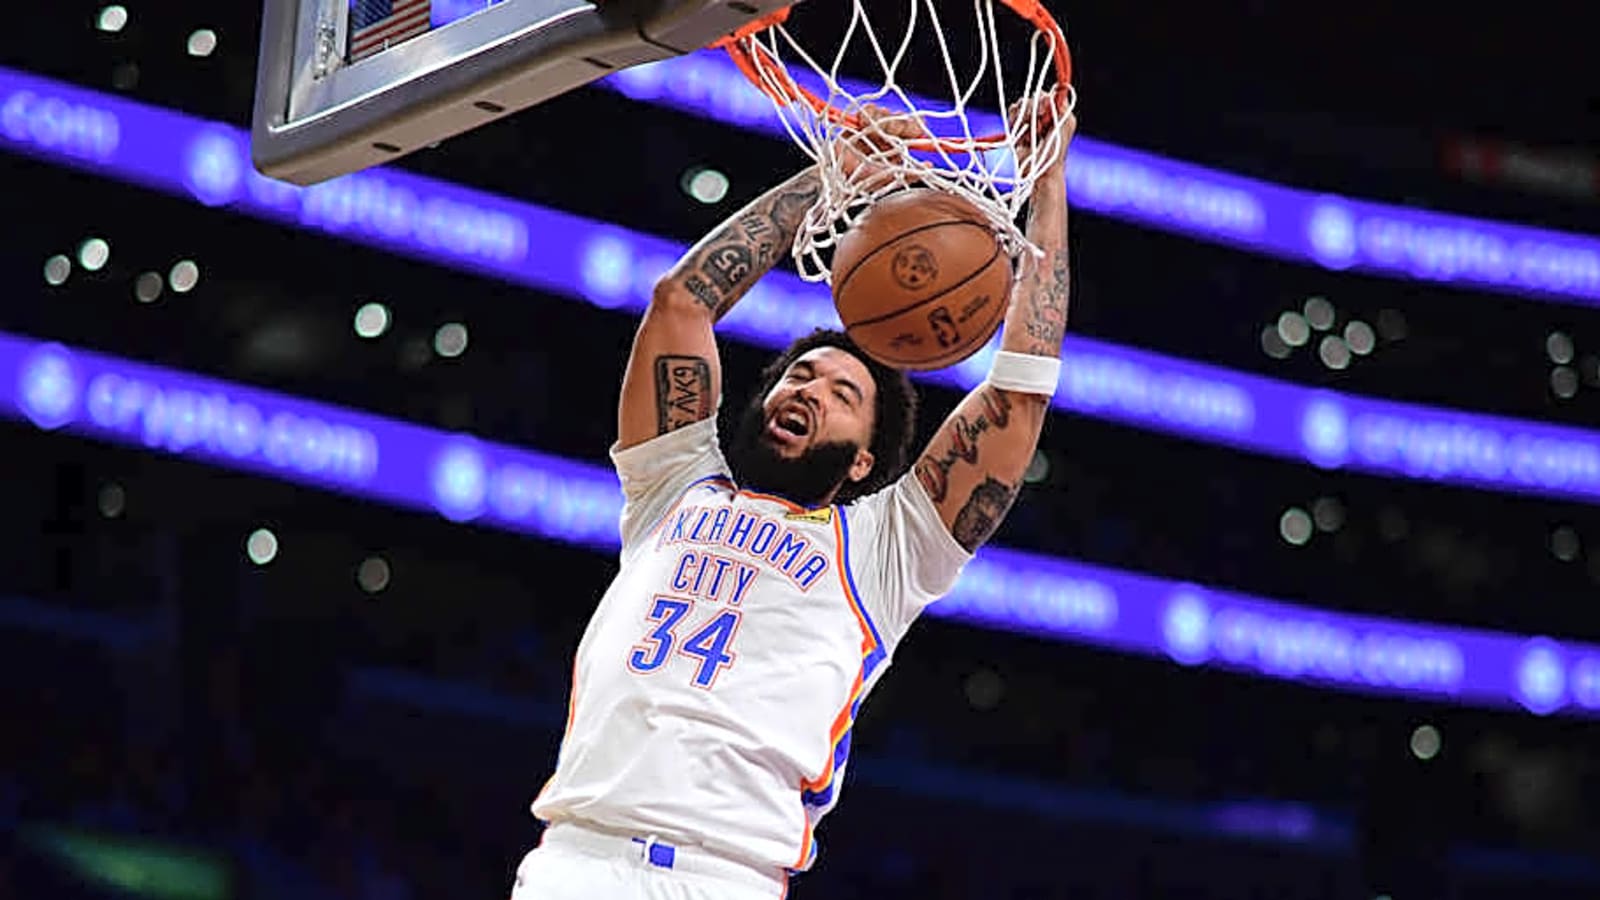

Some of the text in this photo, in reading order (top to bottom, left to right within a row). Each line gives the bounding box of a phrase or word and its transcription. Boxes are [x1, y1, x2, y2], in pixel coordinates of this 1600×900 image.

[657, 505, 829, 592] KLAHOMA
[672, 551, 759, 605] CITY
[628, 594, 742, 690] 34
